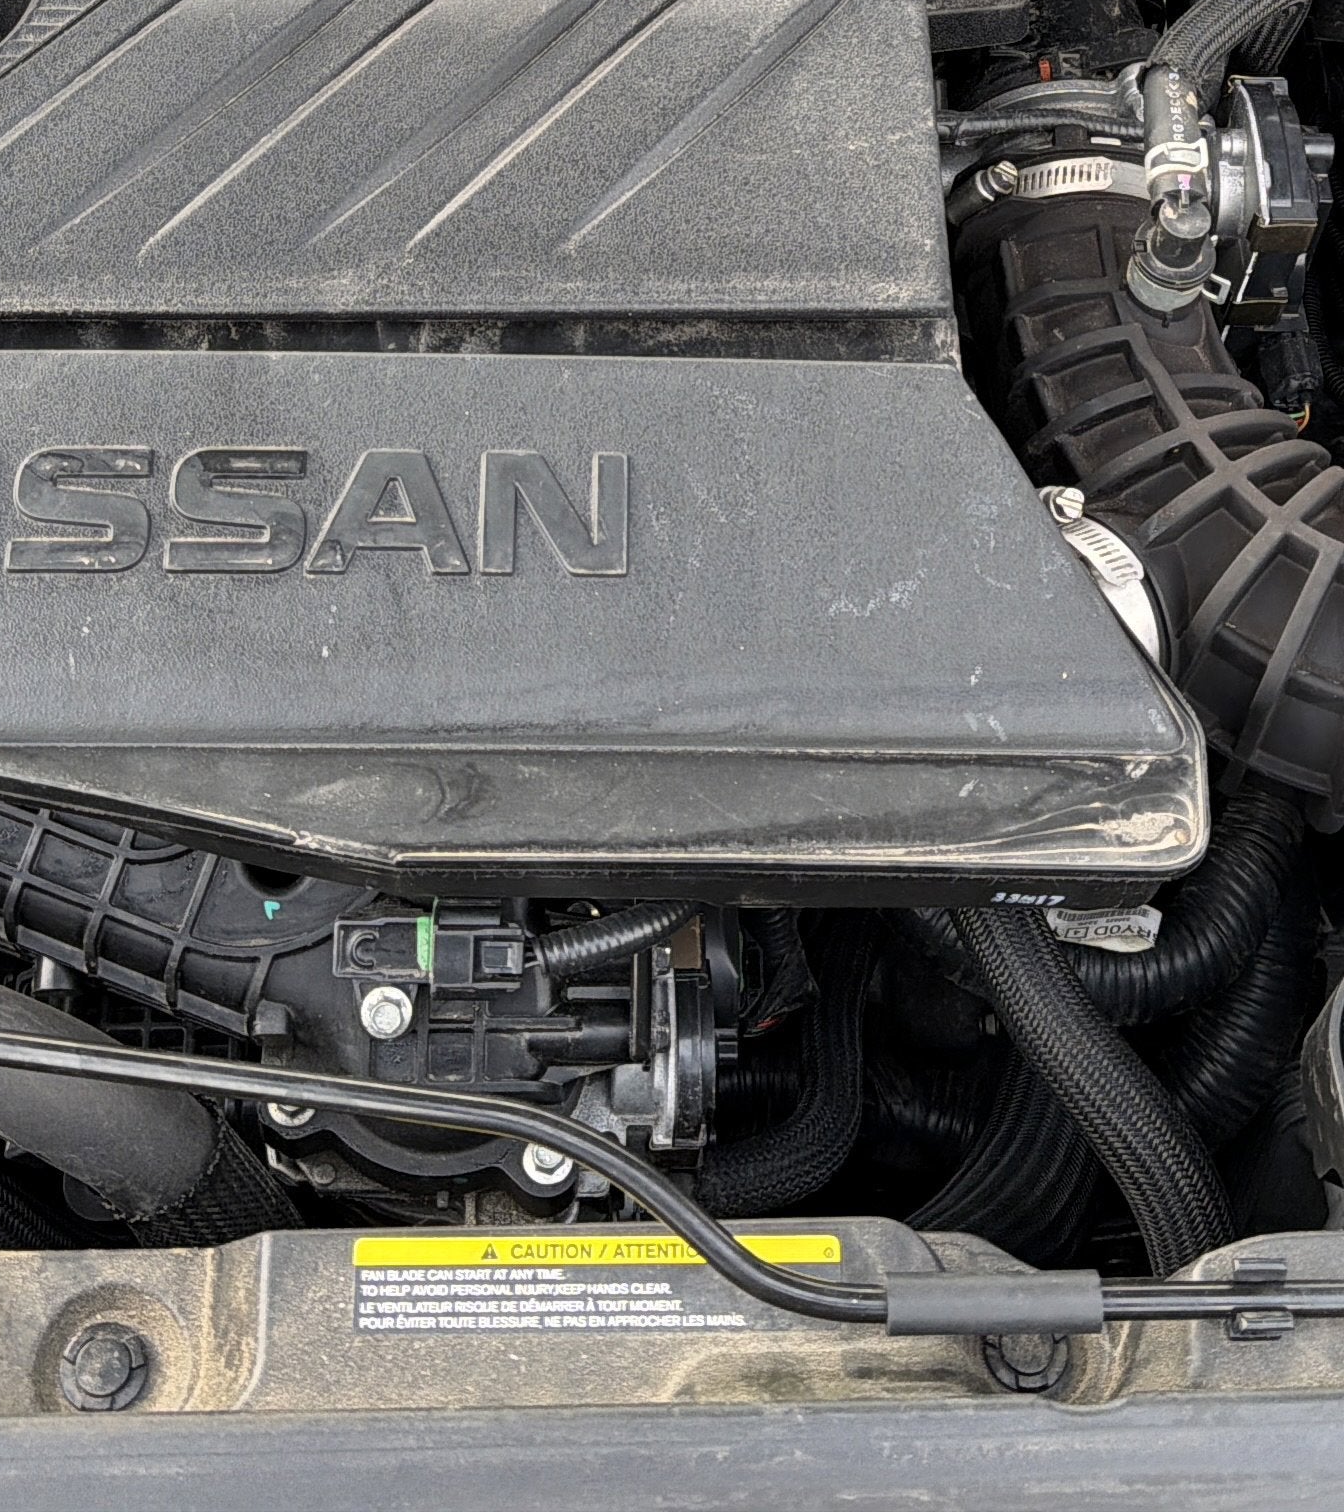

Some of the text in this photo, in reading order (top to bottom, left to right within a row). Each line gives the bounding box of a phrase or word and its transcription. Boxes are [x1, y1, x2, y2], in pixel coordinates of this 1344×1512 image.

[510, 1243, 702, 1259] CAUTION / ATTENTIO
[361, 1270, 385, 1281] FAN
[386, 1269, 425, 1281] BLADE
[427, 1269, 454, 1281] CAN
[455, 1269, 492, 1280] START
[493, 1268, 508, 1280] AT
[509, 1268, 535, 1280] ANY
[360, 1285, 378, 1296] TO
[380, 1284, 410, 1296] HELP
[411, 1284, 448, 1296] AVOID
[450, 1284, 513, 1296] PERSONAL
[587, 1283, 629, 1295] HANDS
[360, 1302, 376, 1313] LE
[376, 1301, 453, 1313] VENTILATEUR
[501, 1301, 518, 1312] DE
[597, 1300, 628, 1312] TOUT
[359, 1317, 396, 1329] POUR
[439, 1317, 476, 1328] TOUTE
[544, 1316, 562, 1328] NE
[563, 1316, 587, 1327] PAS
[588, 1316, 606, 1327] EN
[607, 1315, 681, 1327] APPROCHER
[682, 1315, 705, 1326] LES
